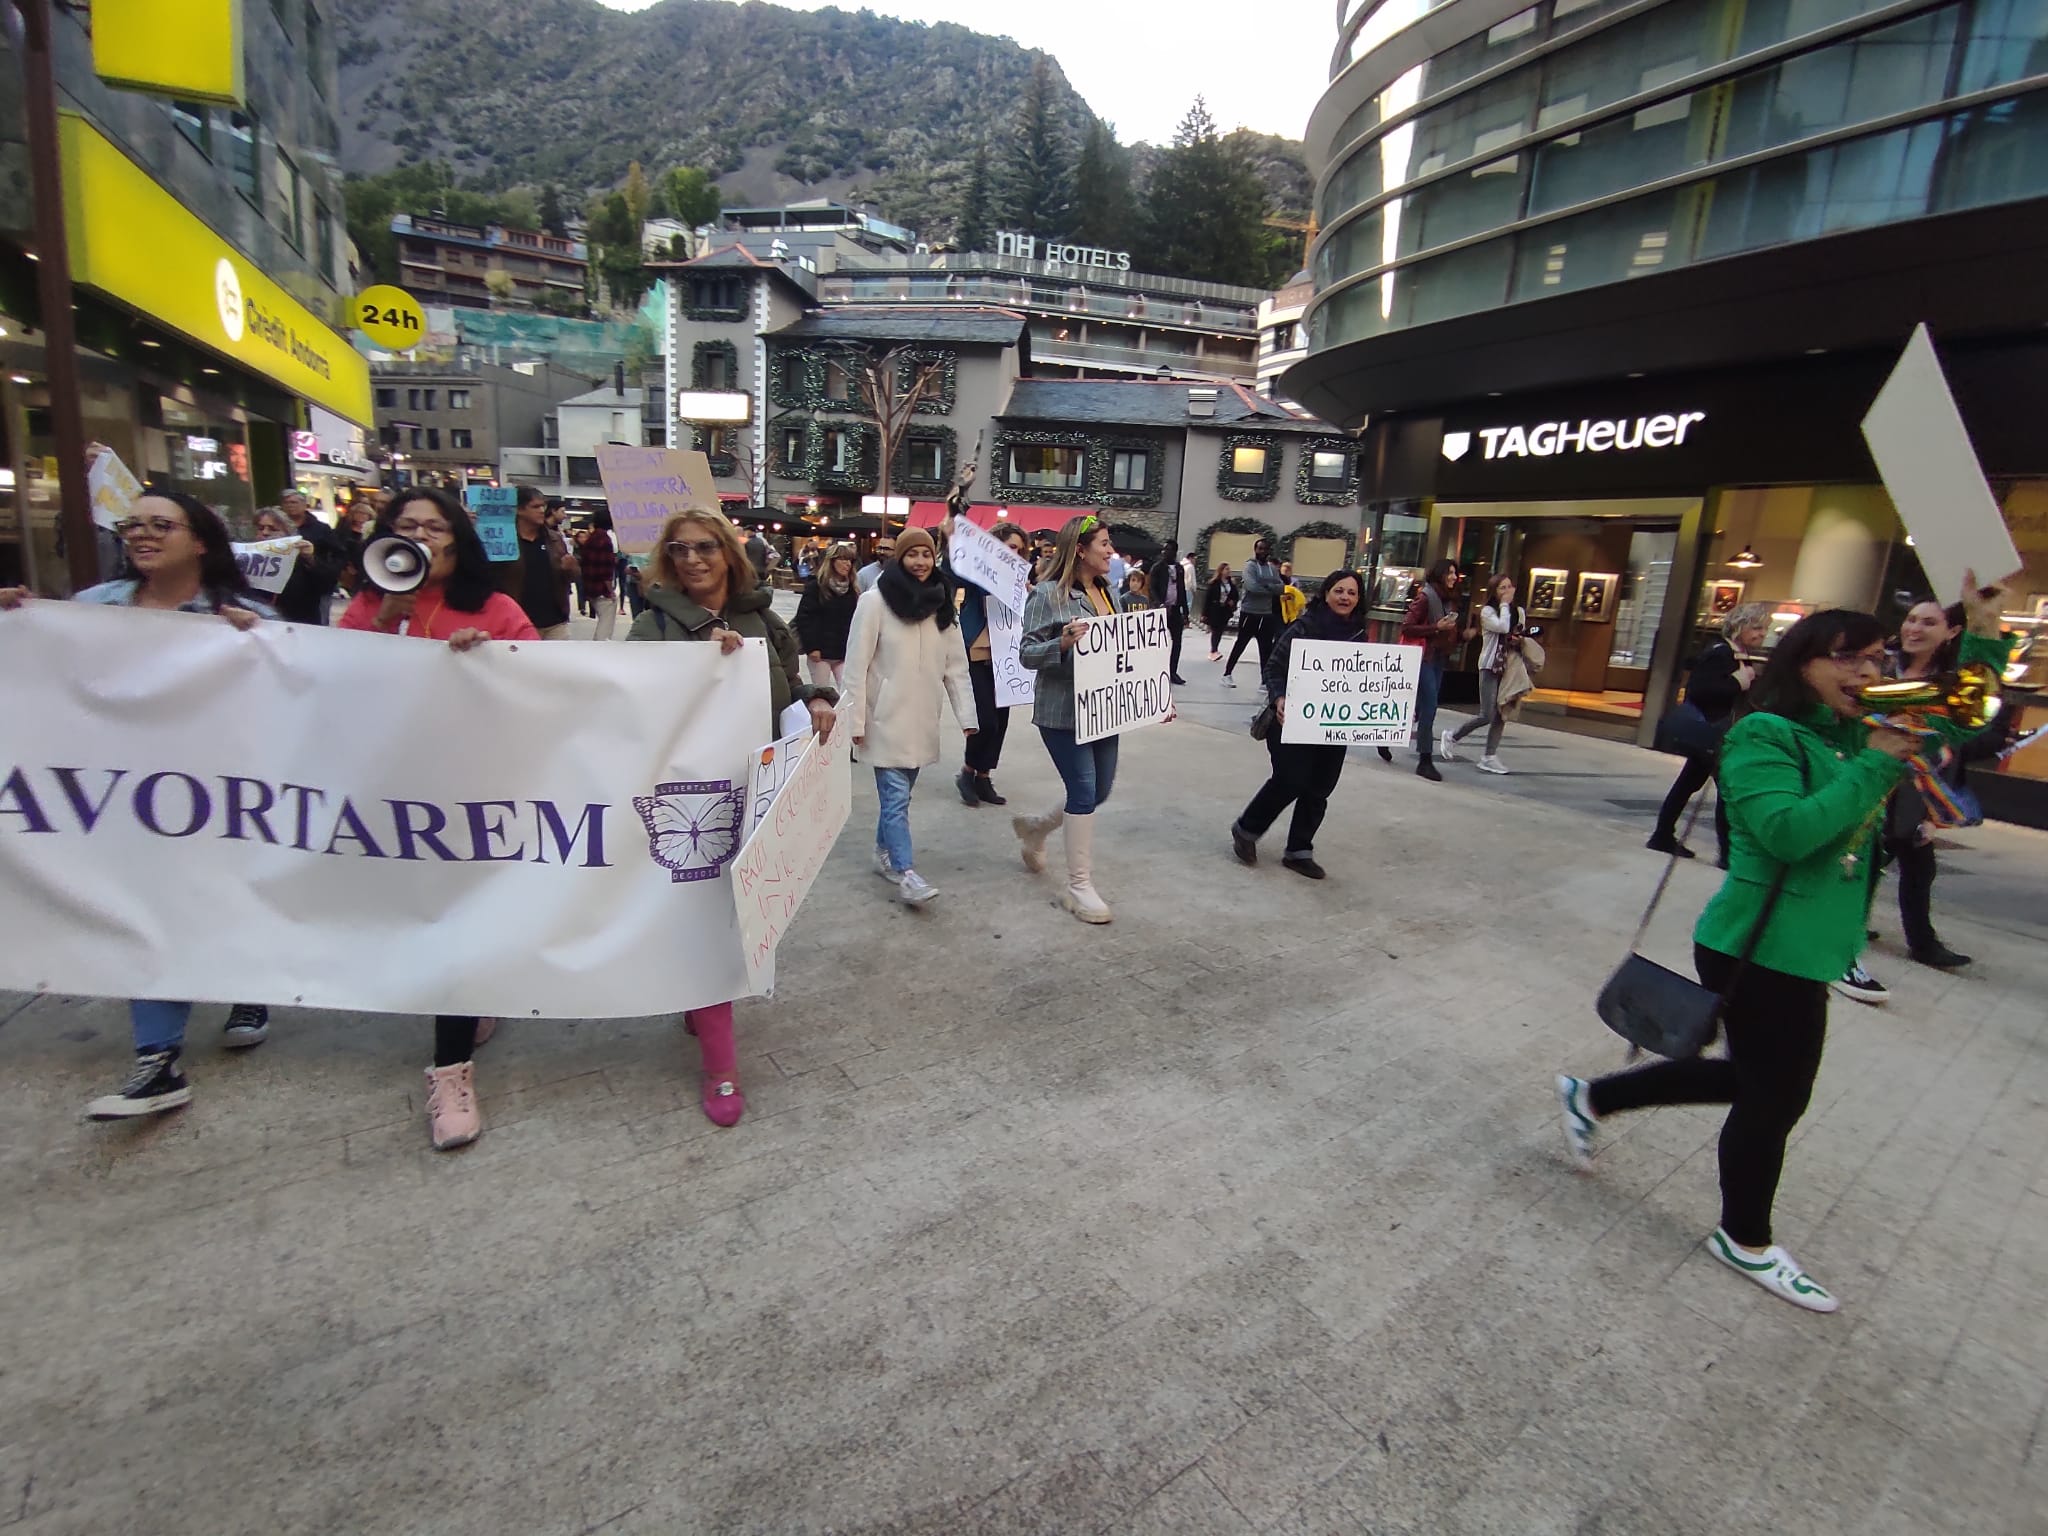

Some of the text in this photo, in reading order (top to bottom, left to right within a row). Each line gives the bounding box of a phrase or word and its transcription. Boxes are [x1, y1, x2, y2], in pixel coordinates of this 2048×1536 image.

[1046, 243, 1131, 271] HOTELS
[362, 304, 419, 330] 24h
[1076, 612, 1168, 656] COMIENZA
[1116, 651, 1134, 673] EL
[1301, 649, 1403, 673] La maternitat
[1321, 675, 1413, 698] serà desitjada
[1321, 702, 1351, 721] NO
[0, 765, 613, 868] AVORTAREM
[672, 868, 719, 881] DECIDIR
